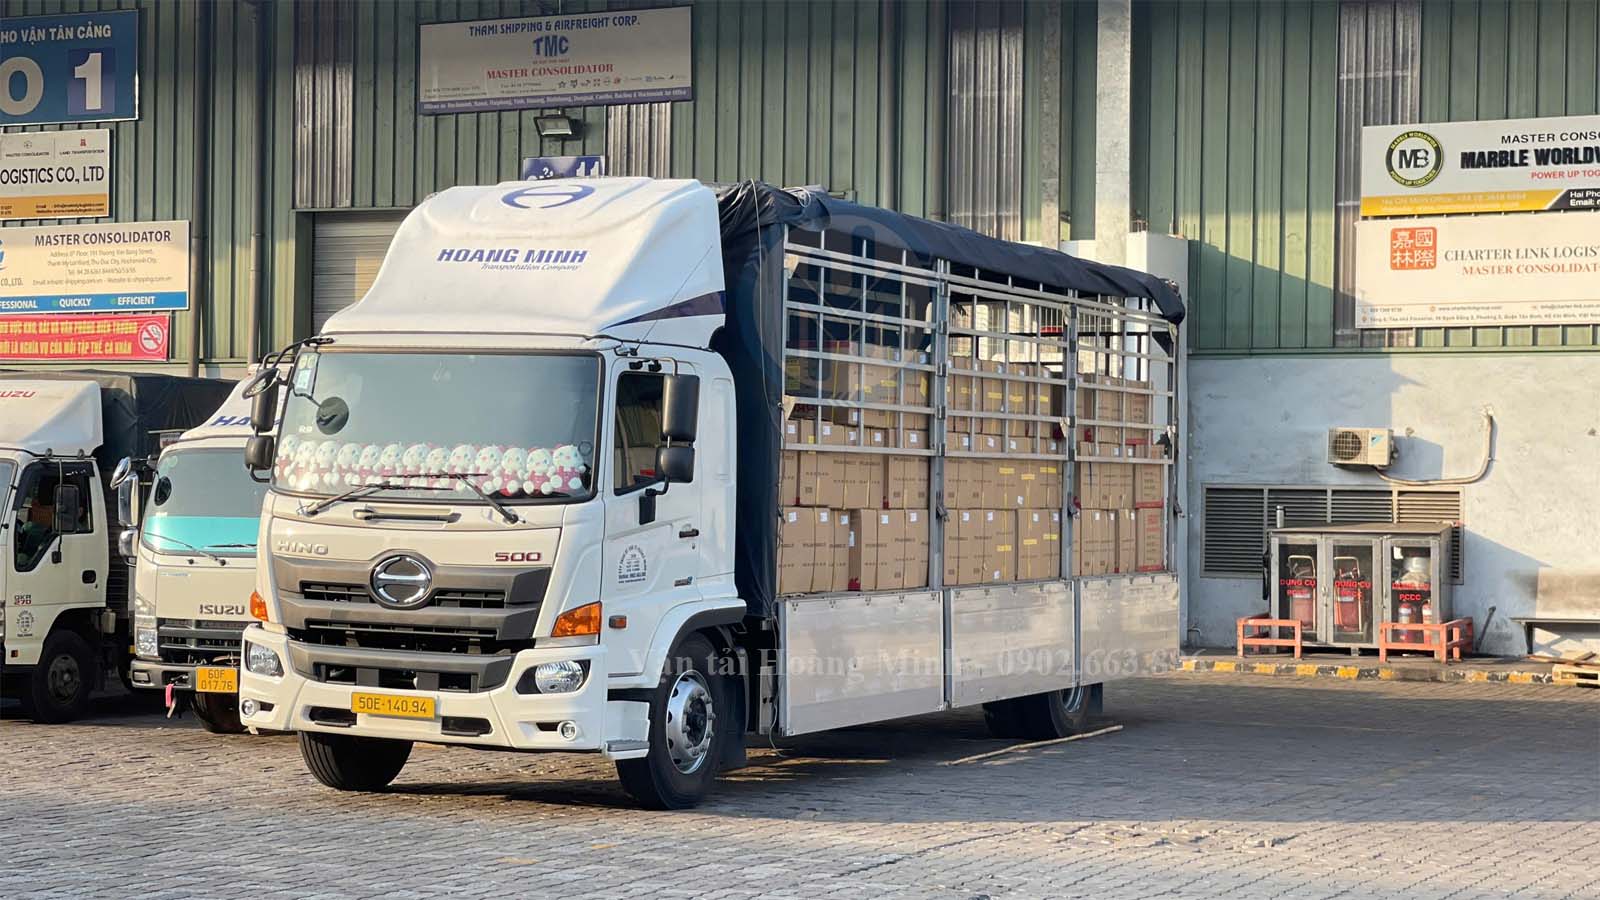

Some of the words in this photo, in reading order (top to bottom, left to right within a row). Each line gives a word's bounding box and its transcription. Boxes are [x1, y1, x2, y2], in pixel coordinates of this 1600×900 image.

[21, 26, 45, 45] VẬN
[50, 24, 74, 40] TÂN
[77, 20, 111, 39] CẢNG
[469, 26, 498, 37] THAMI
[500, 22, 543, 34] SHIPPING
[545, 21, 552, 31] &
[554, 18, 609, 31] AIRFREIGHT
[612, 16, 640, 27] CORP.
[533, 35, 569, 57] TMC
[486, 68, 528, 80] MASTER
[531, 63, 614, 77] CONSOLIDATOR
[74, 52, 102, 110] 1
[1501, 134, 1555, 144] MASTER
[1560, 132, 1600, 141] CONS
[1399, 149, 1429, 169] MB
[1461, 150, 1528, 169] MARBLE
[0, 168, 53, 184] OGISTICS
[83, 166, 104, 181] LTD
[35, 234, 80, 246] MASTER
[83, 230, 171, 244] CONSOLIDATOR
[436, 248, 519, 263] HOANG
[525, 250, 589, 263] MINH
[1444, 249, 1513, 262] CHARTER
[1516, 248, 1551, 260] LINK
[480, 262, 540, 271] Transportation
[1462, 266, 1514, 276] MASTER
[1516, 263, 1600, 274] CONSOLIDAT
[59, 298, 91, 308] QUICKLY
[117, 296, 156, 306] EFFICIENT
[277, 539, 329, 555] HINO
[494, 551, 541, 563] 500
[199, 604, 245, 616] ISUZU
[208, 669, 225, 680] 60F
[200, 679, 233, 690] 017.76
[358, 696, 427, 715] 50E-140.94
